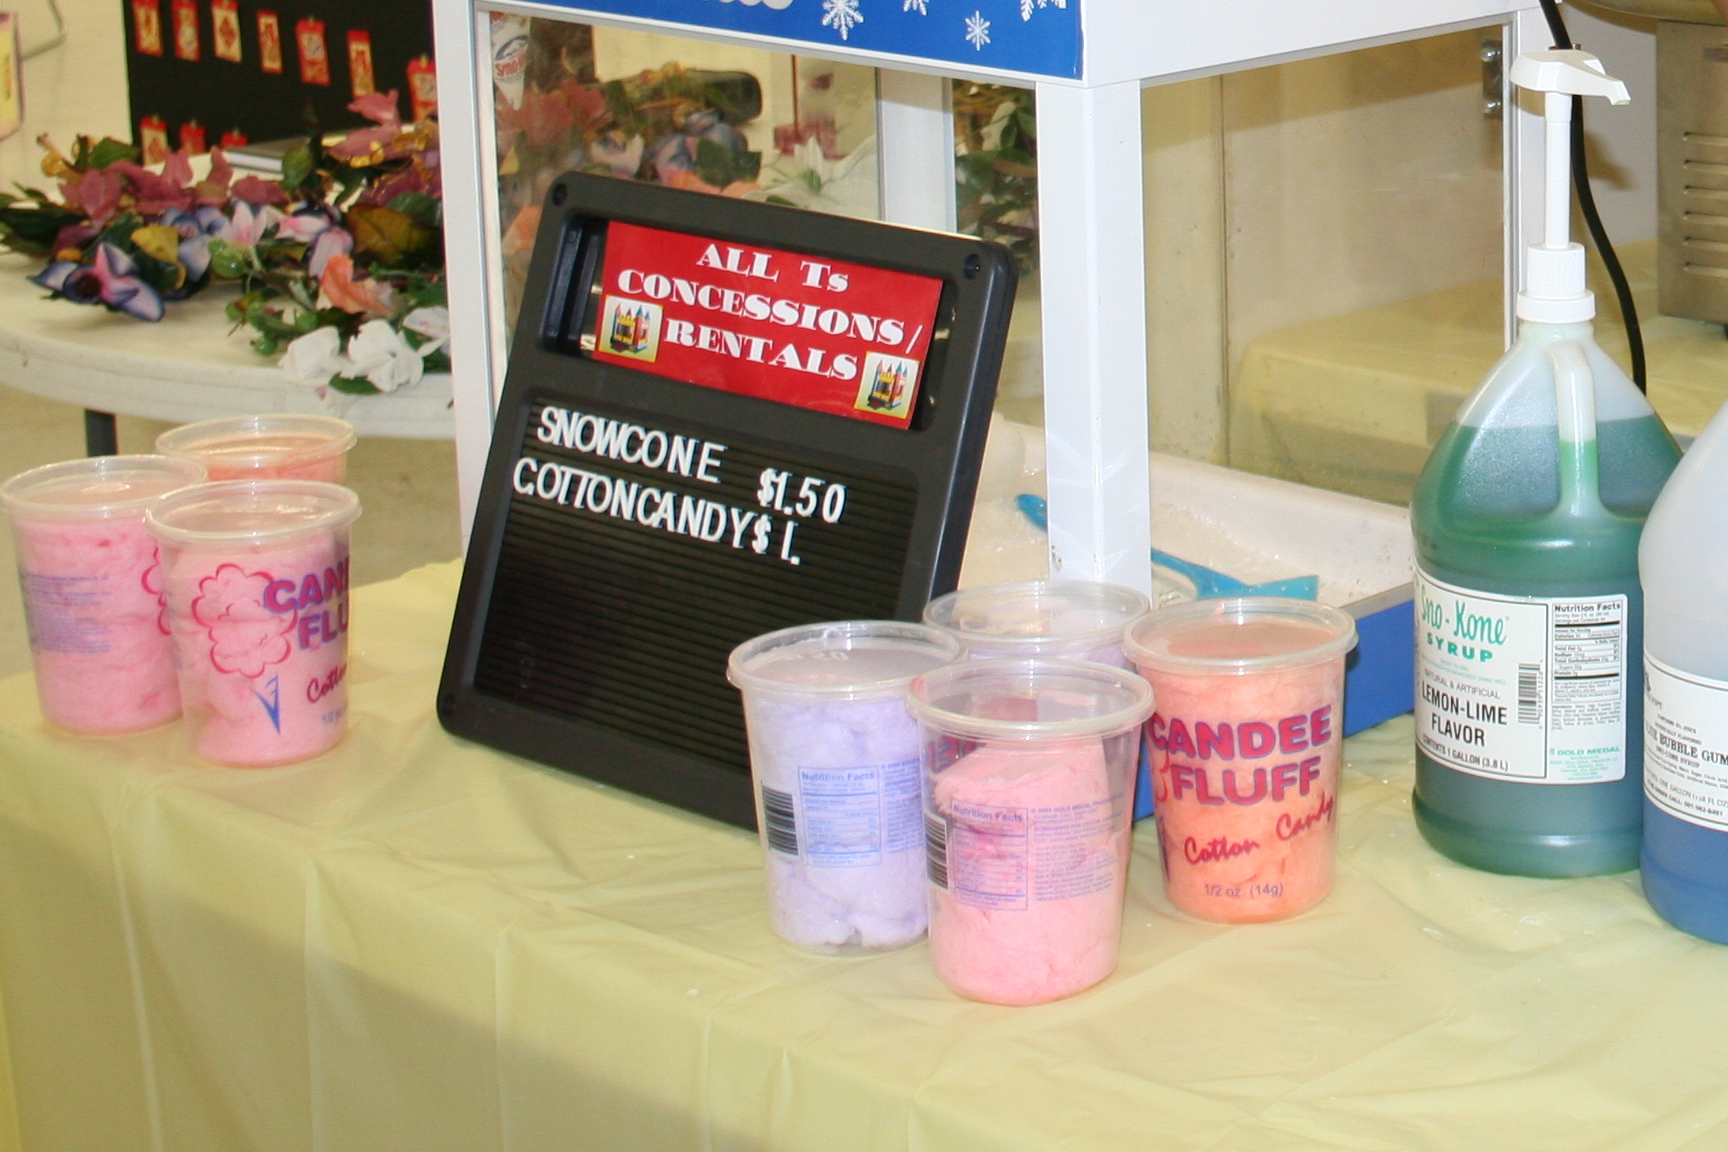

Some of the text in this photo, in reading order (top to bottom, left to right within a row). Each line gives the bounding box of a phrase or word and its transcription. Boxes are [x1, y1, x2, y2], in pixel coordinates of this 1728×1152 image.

[697, 243, 849, 292] ALL Ts
[664, 318, 858, 381] RENTALS
[537, 406, 847, 524] SNOWCONE $1.50
[1555, 602, 1621, 613] Nutrition Facts
[1427, 632, 1493, 662] SYRUP
[1422, 680, 1508, 726] LEMON-LIME
[1456, 683, 1500, 700] ARTIFICIAL
[1148, 704, 1332, 760] CANDEE
[1431, 712, 1485, 748] FLAVOR
[1660, 734, 1698, 759] BUBBLE
[1452, 750, 1480, 765] GALLON
[847, 772, 875, 781] Facts
[1170, 755, 1321, 806] FLUFF
[995, 812, 1023, 823] Facts
[1184, 792, 1334, 865] Cotton Candy
[1204, 883, 1222, 897] 1/2
